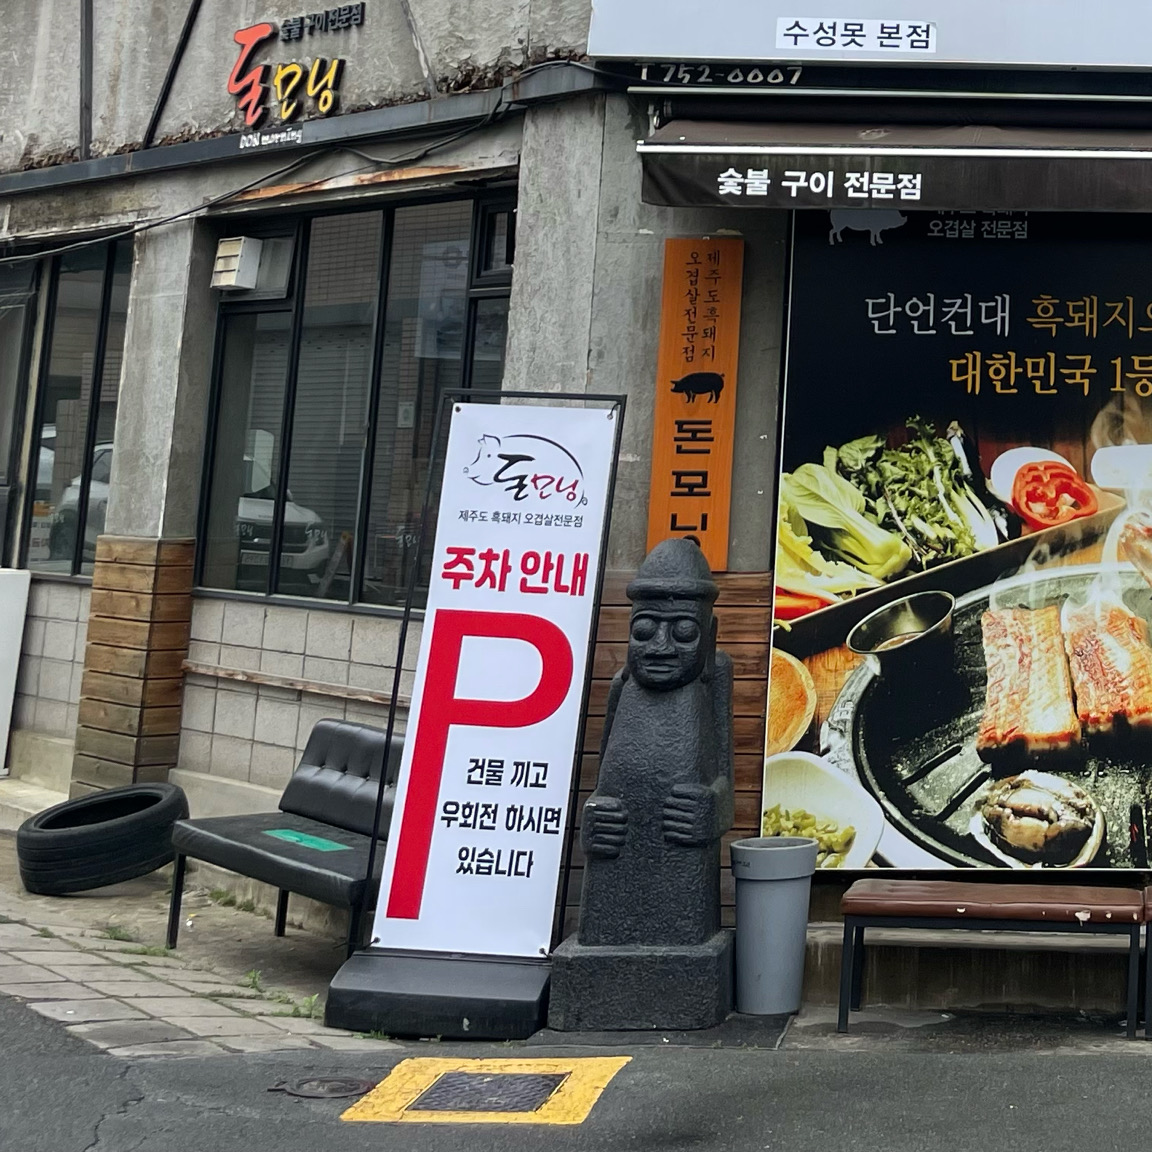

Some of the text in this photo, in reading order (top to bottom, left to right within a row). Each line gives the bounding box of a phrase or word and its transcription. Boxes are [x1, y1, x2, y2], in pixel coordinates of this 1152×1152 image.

[783, 20, 931, 50] 수성못 본점
[660, 64, 803, 85] 752-0007
[716, 168, 923, 200] 숯불 구이 전문점
[927, 220, 1028, 239] 오겹살 전문점
[865, 293, 1010, 337] 단언컨대
[949, 351, 1097, 397] 대한민국
[458, 509, 583, 528] 제주도 흑돼지 오겹살전문점
[441, 547, 589, 597] 주차 안내
[386, 608, 574, 919] P
[466, 757, 548, 789] 건물 끼고
[440, 801, 561, 836] 우회전 하시면
[455, 847, 535, 878] 있습니다
